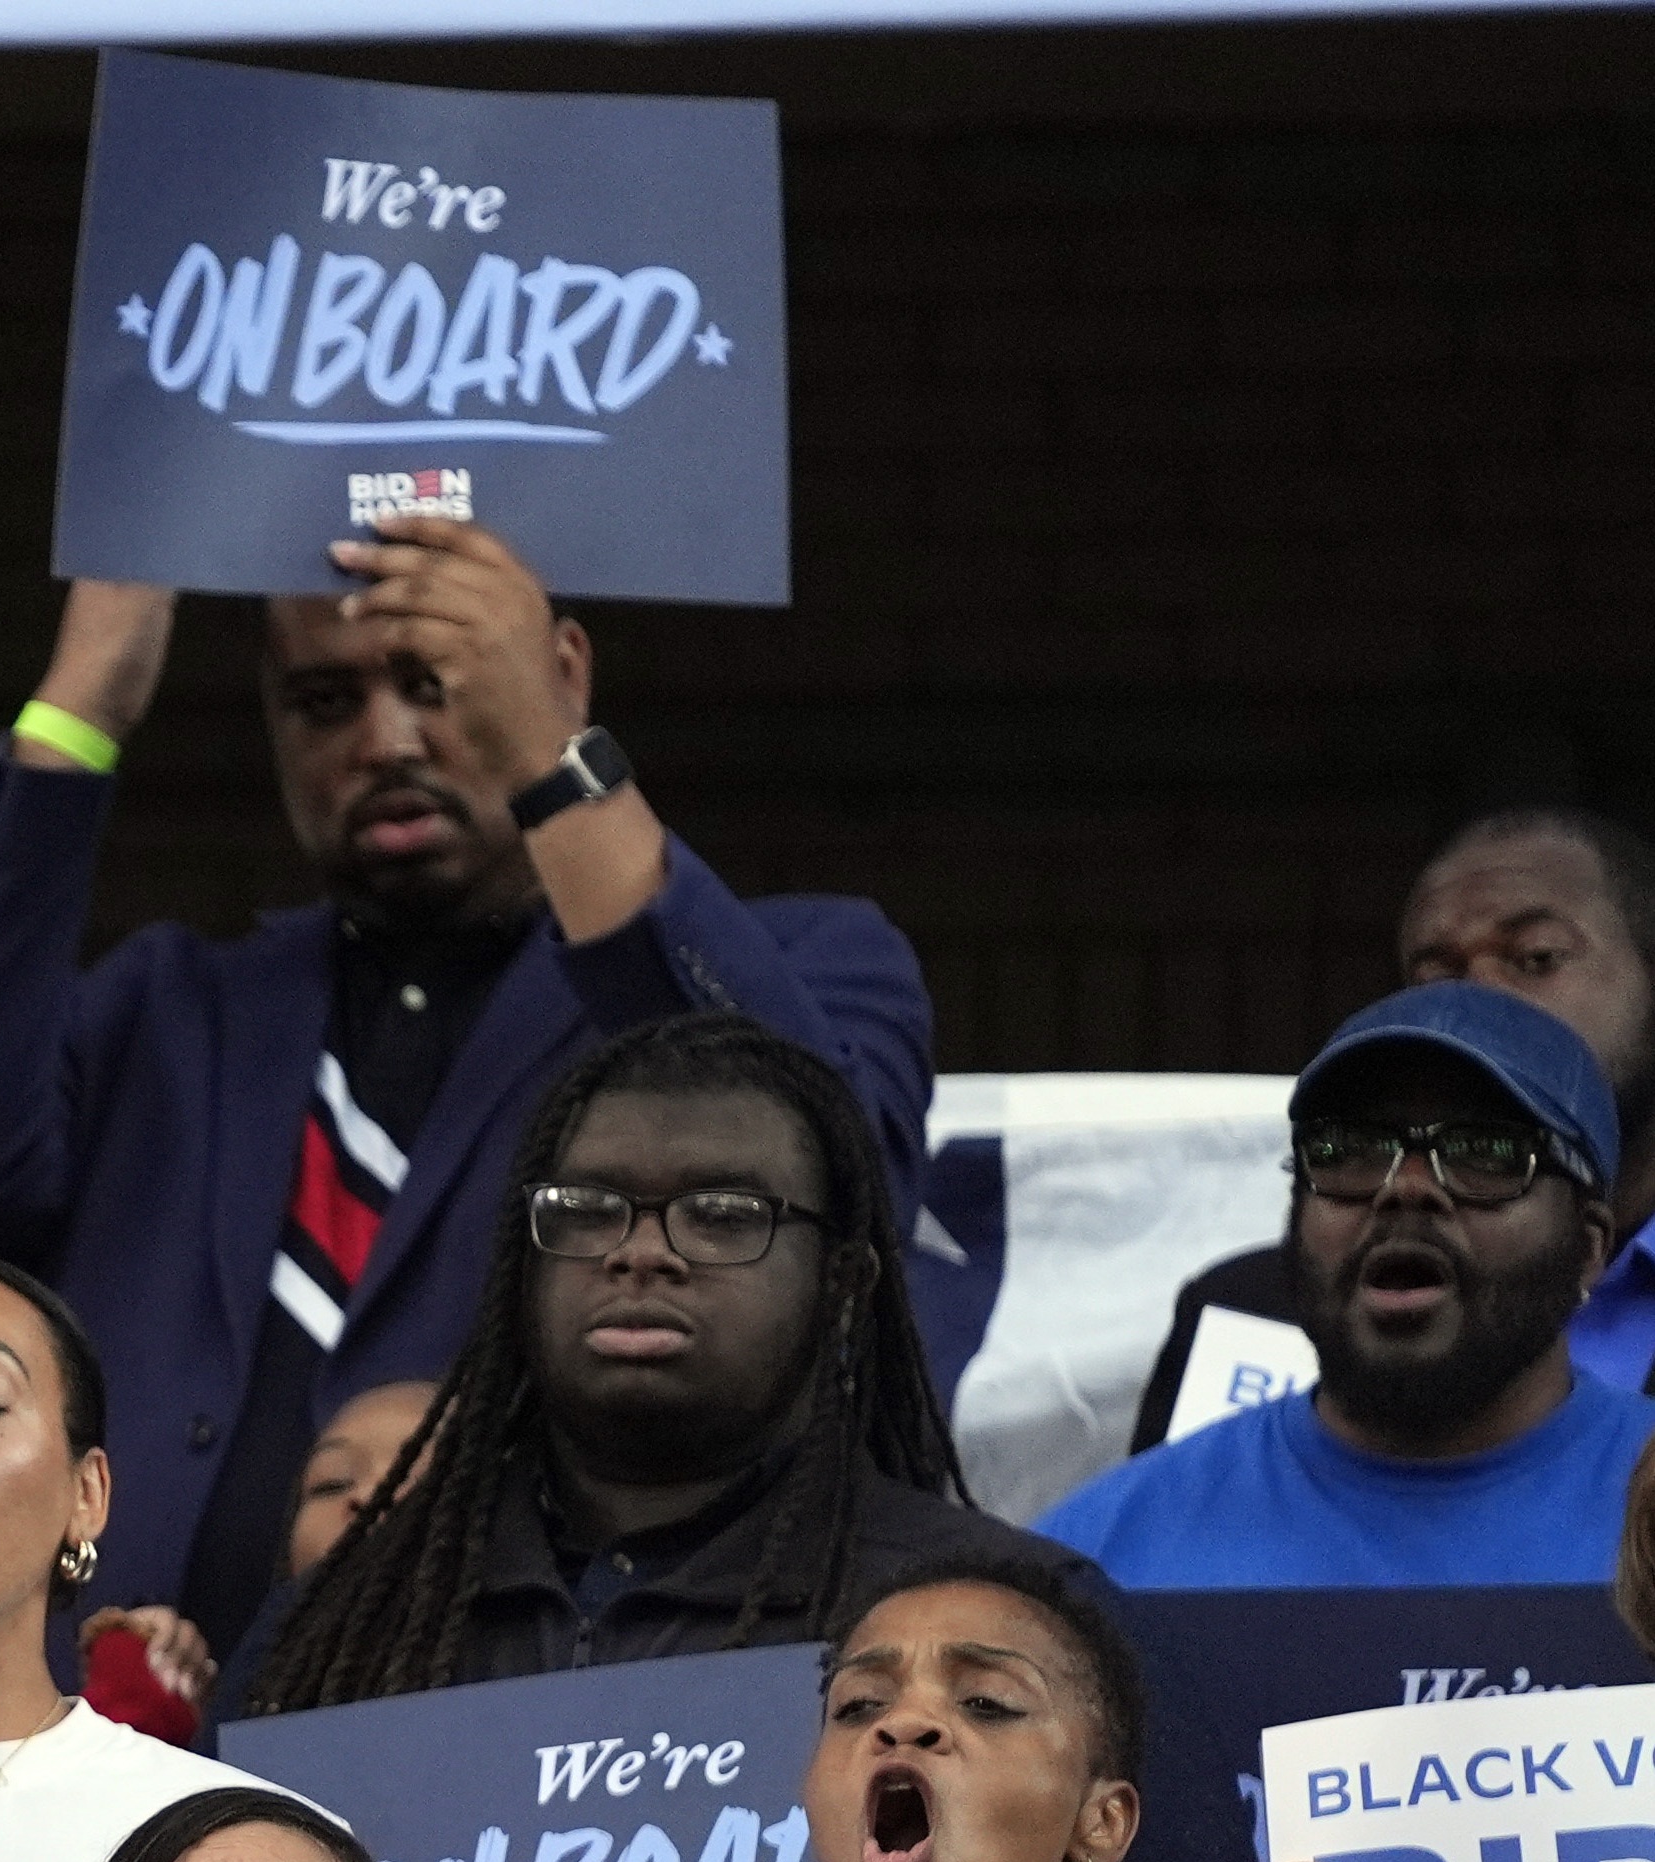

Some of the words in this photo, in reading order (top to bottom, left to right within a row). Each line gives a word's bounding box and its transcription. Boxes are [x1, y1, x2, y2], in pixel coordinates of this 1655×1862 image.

[321, 157, 507, 233] We're
[148, 232, 300, 412] ON
[293, 252, 701, 415] BOARD
[347, 467, 472, 500] BIDEN
[535, 1731, 746, 1806] We're
[1308, 1741, 1574, 1819] BLACK
